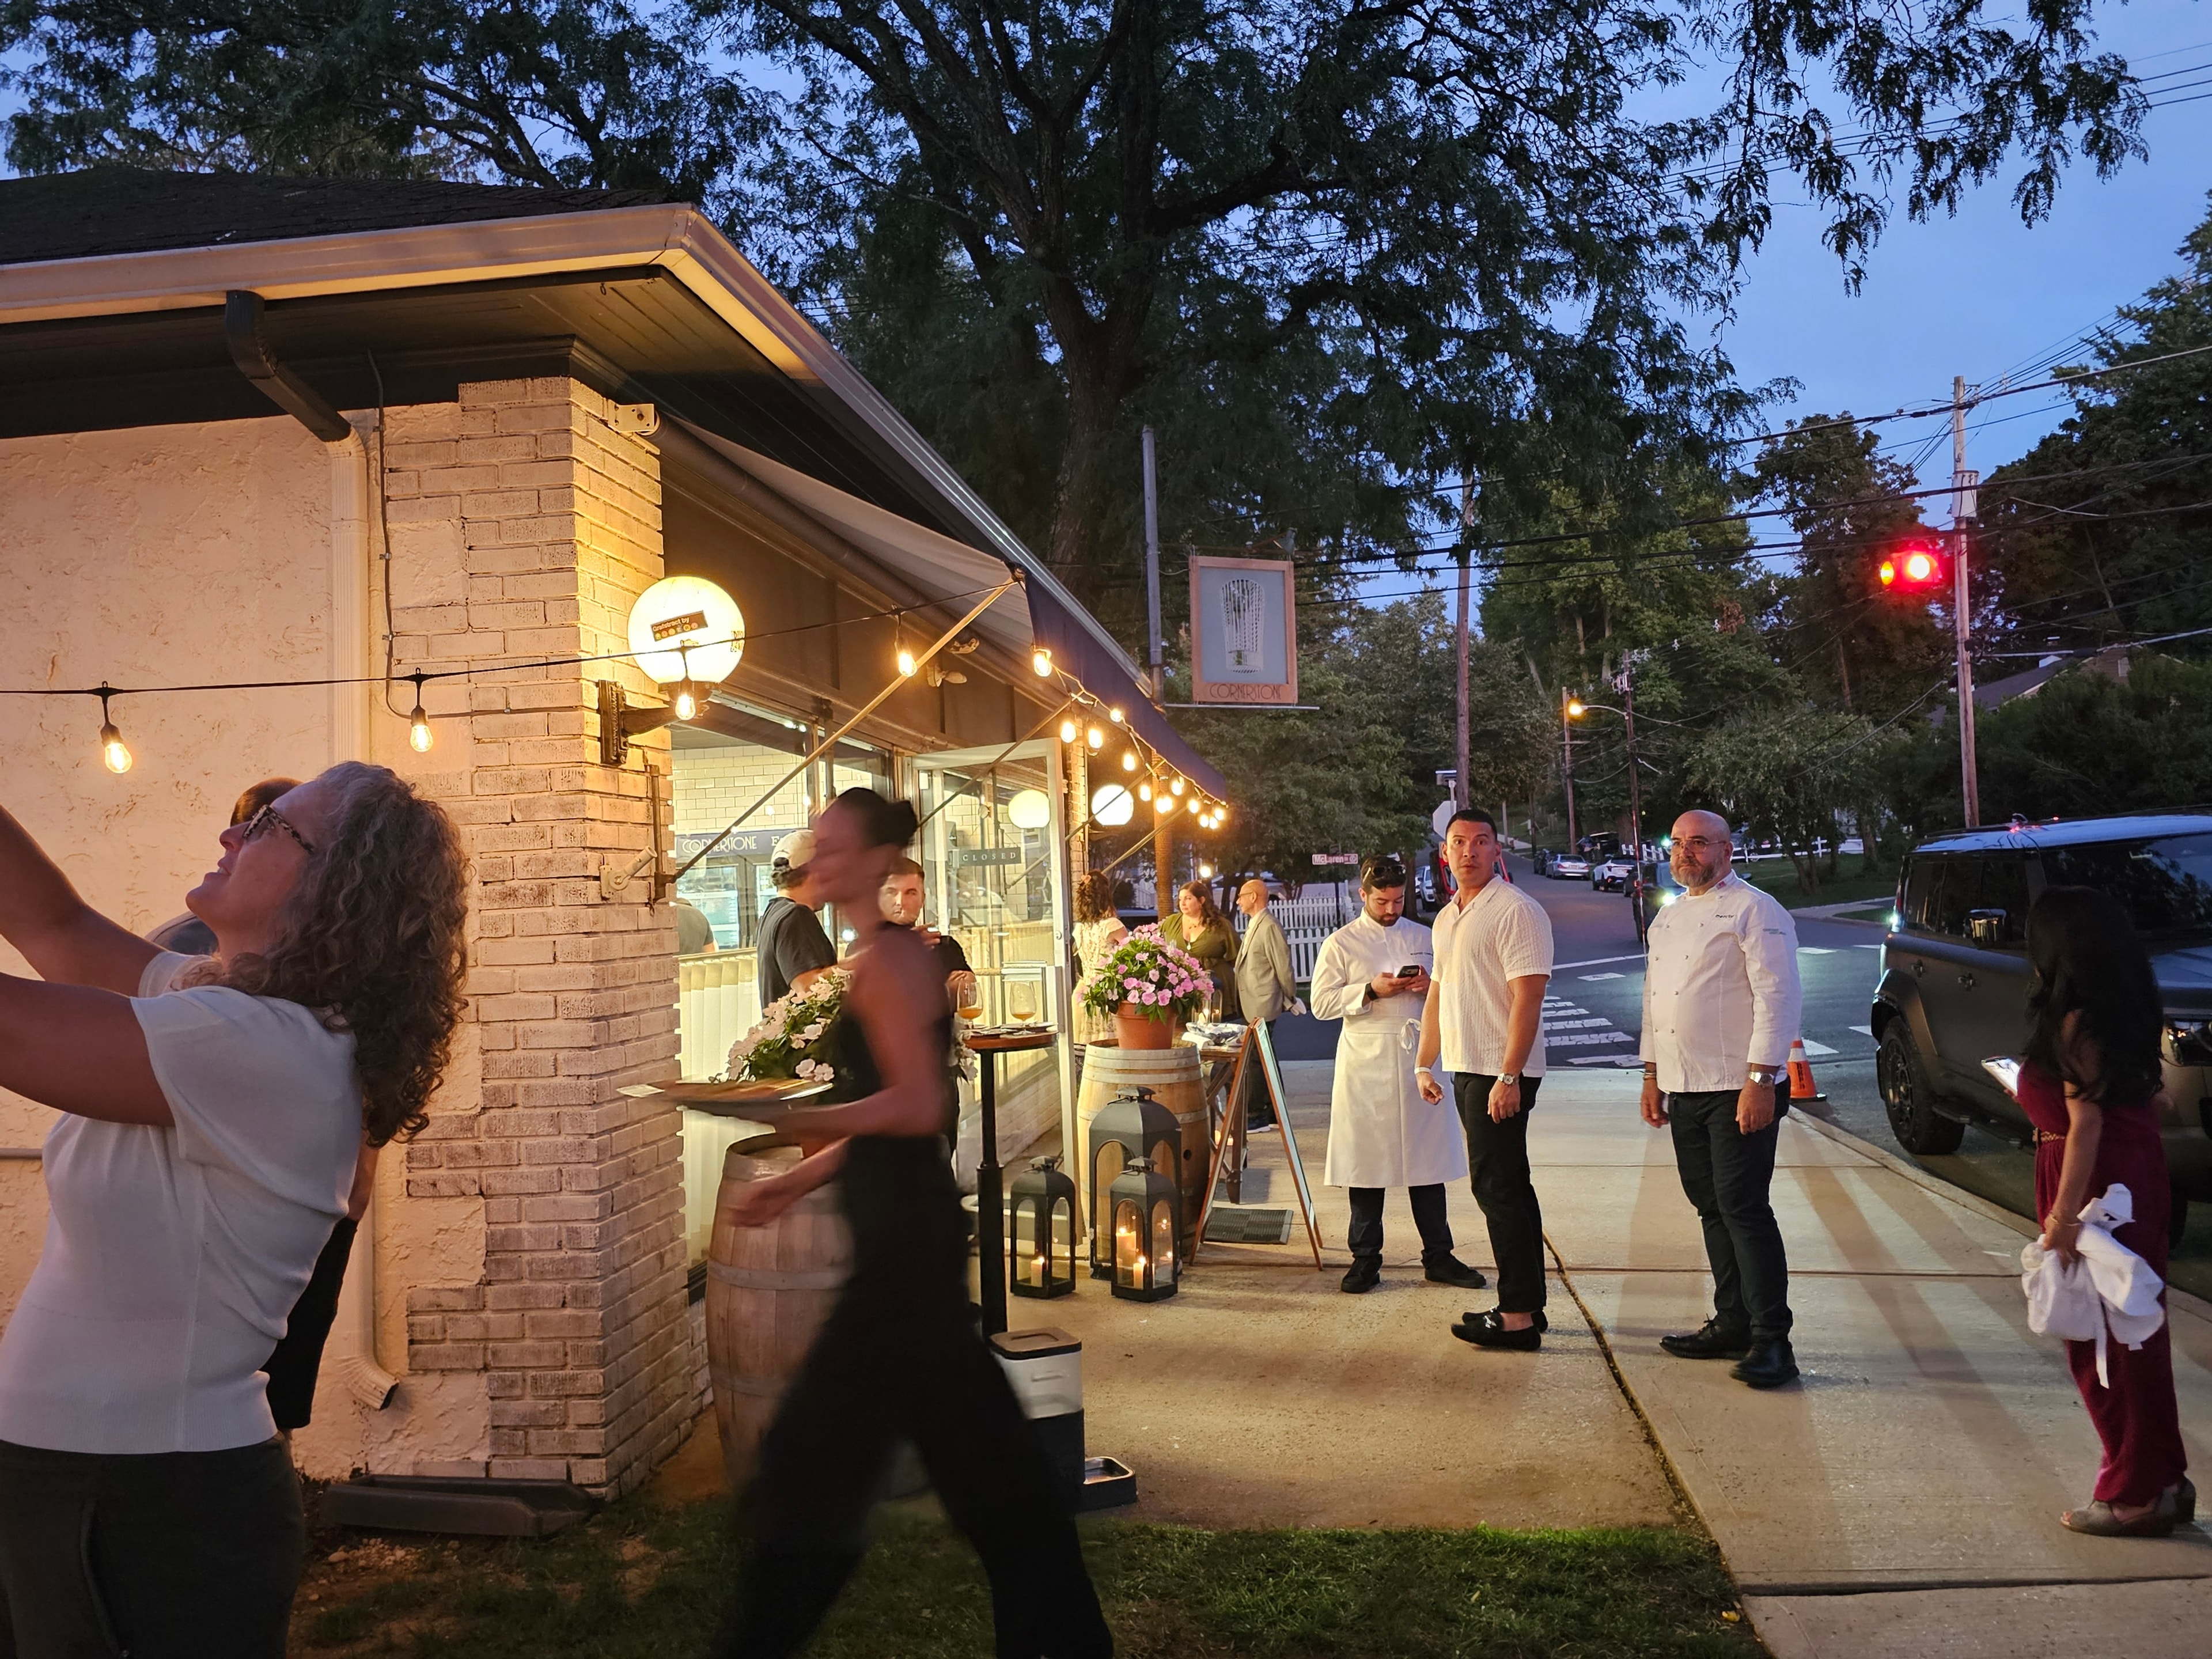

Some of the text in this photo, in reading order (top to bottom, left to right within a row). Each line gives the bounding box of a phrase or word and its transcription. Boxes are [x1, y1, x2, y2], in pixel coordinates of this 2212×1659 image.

[1209, 683, 1281, 701] CORNERSTONE
[962, 852, 1016, 862] CLOSED
[1313, 855, 1344, 863] McLaren
